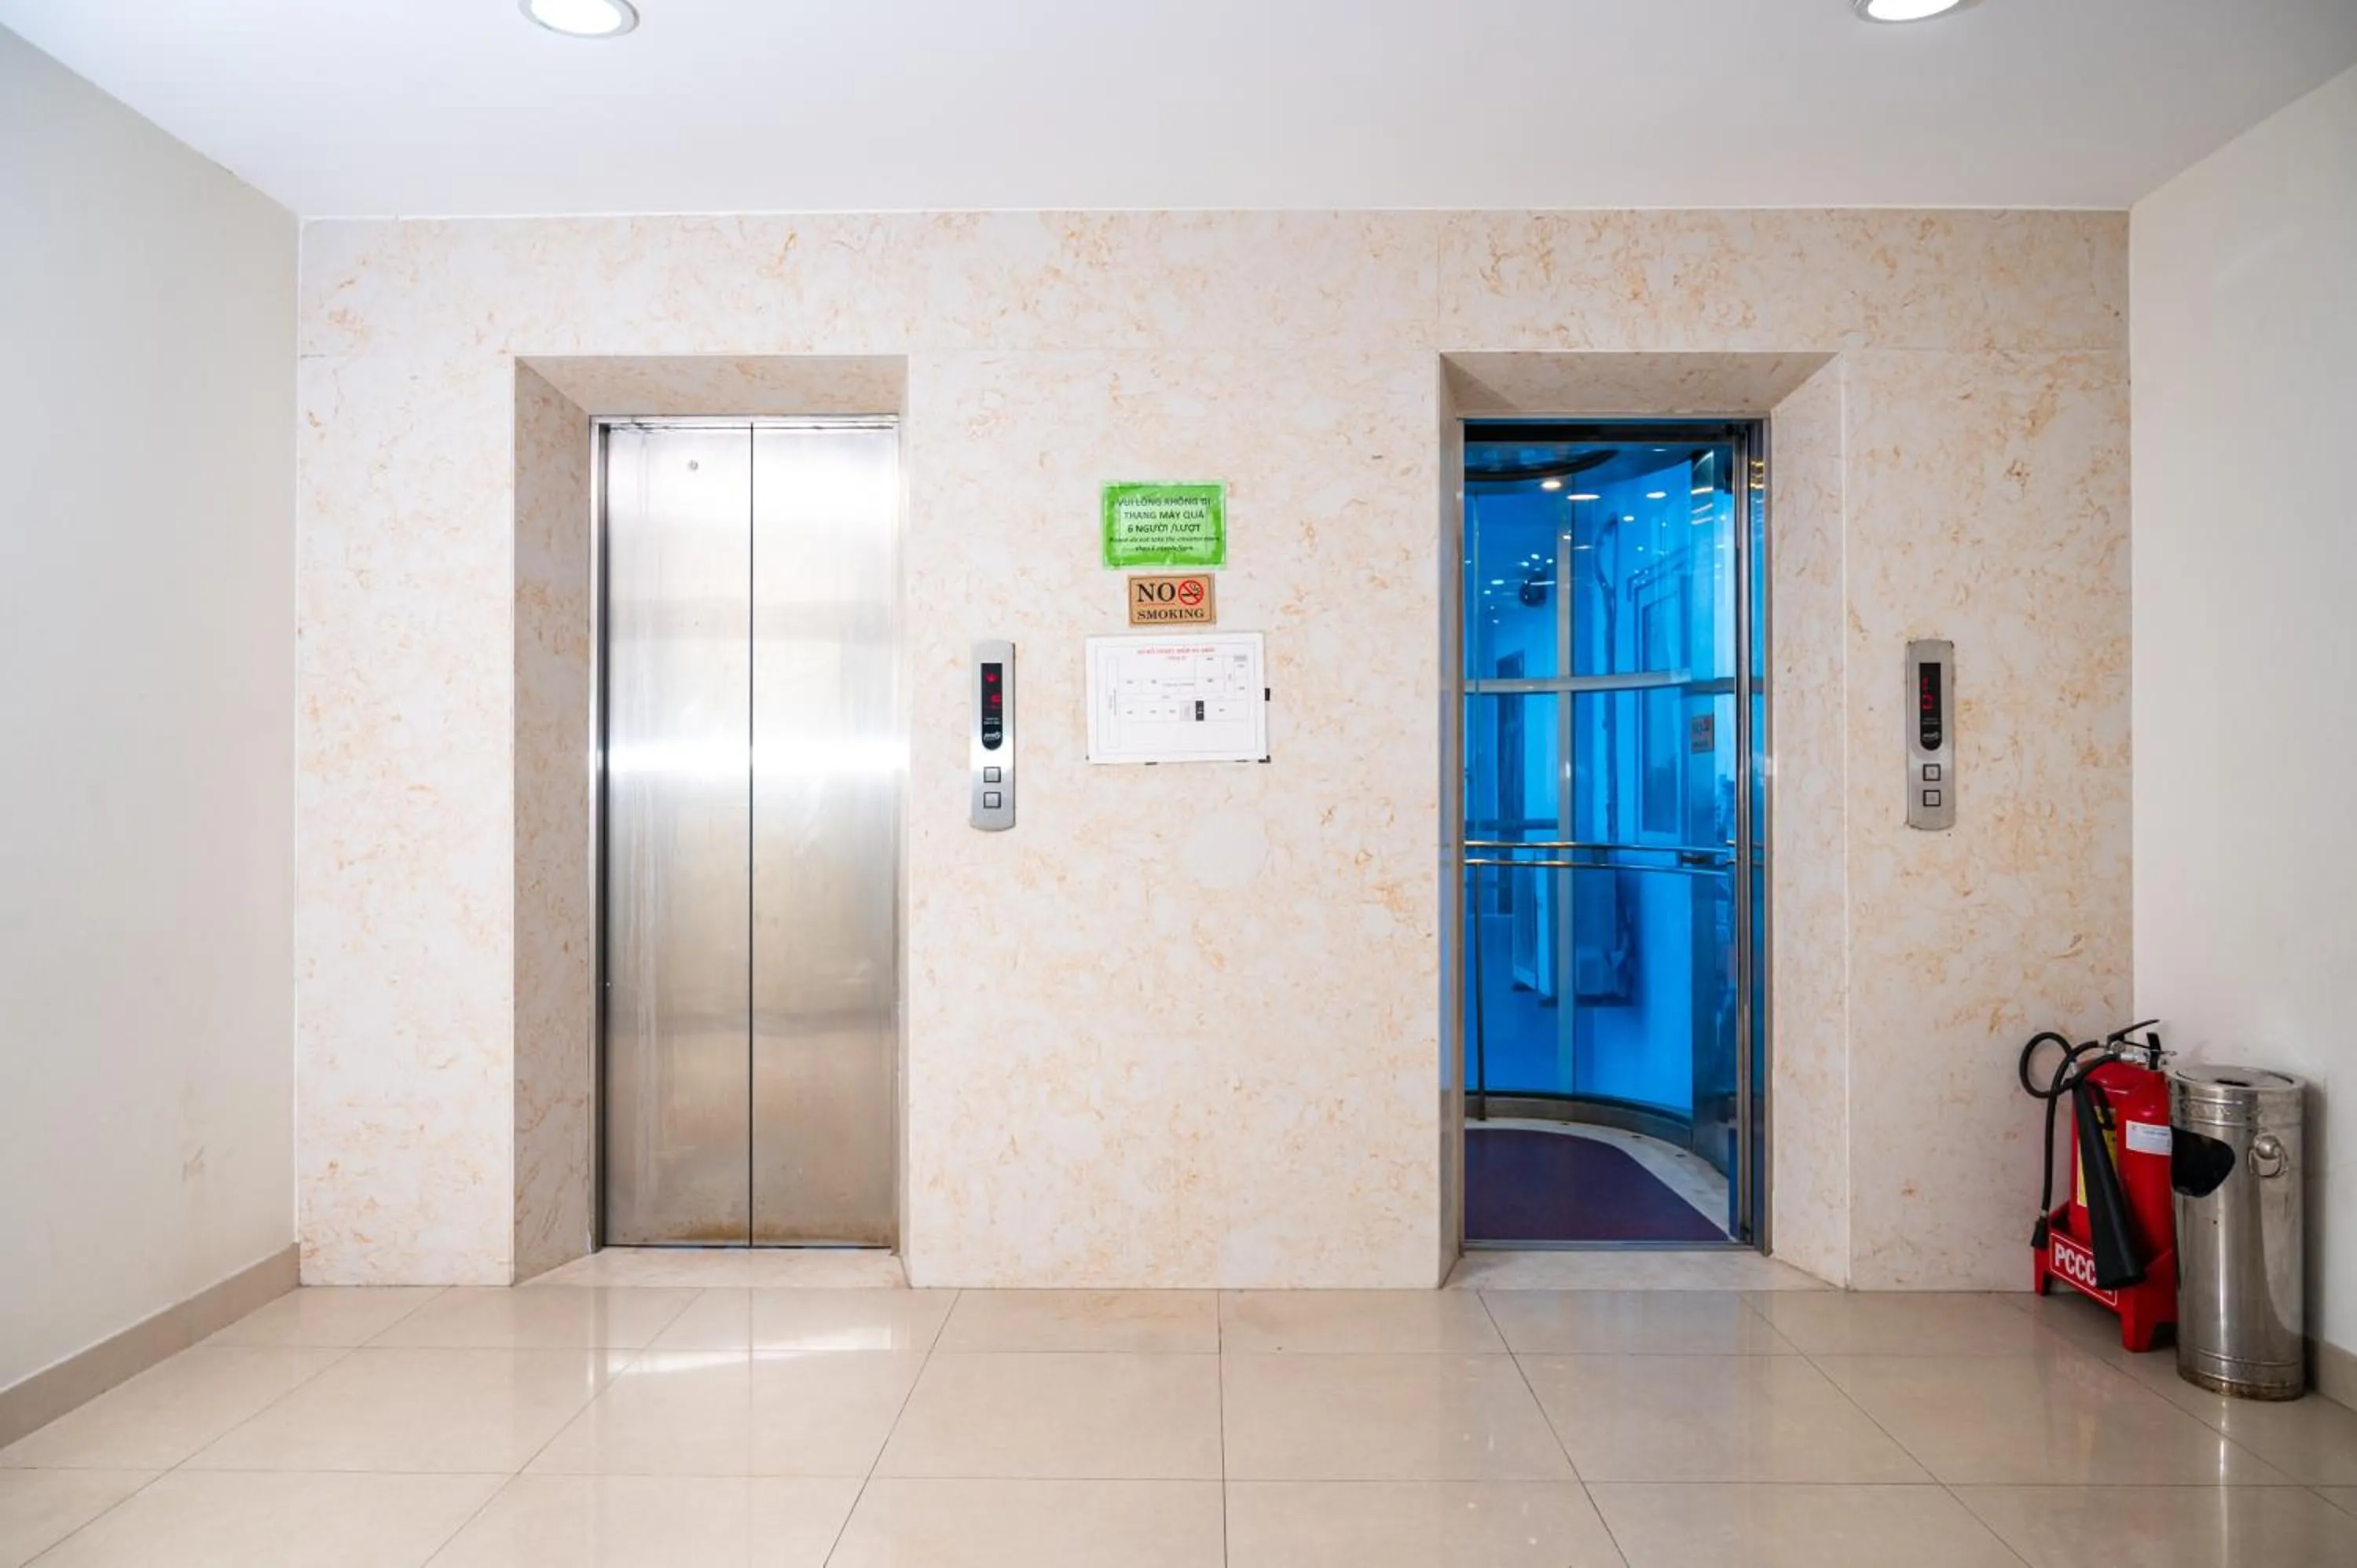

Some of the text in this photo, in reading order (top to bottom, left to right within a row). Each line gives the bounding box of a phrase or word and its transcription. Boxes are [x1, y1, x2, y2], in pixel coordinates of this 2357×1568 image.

[1124, 511, 1157, 519] THANG
[1127, 523, 1134, 533] 6
[1136, 582, 1176, 603] NO
[1136, 608, 1204, 620] SMOKING
[2055, 1241, 2098, 1288] PCCC
